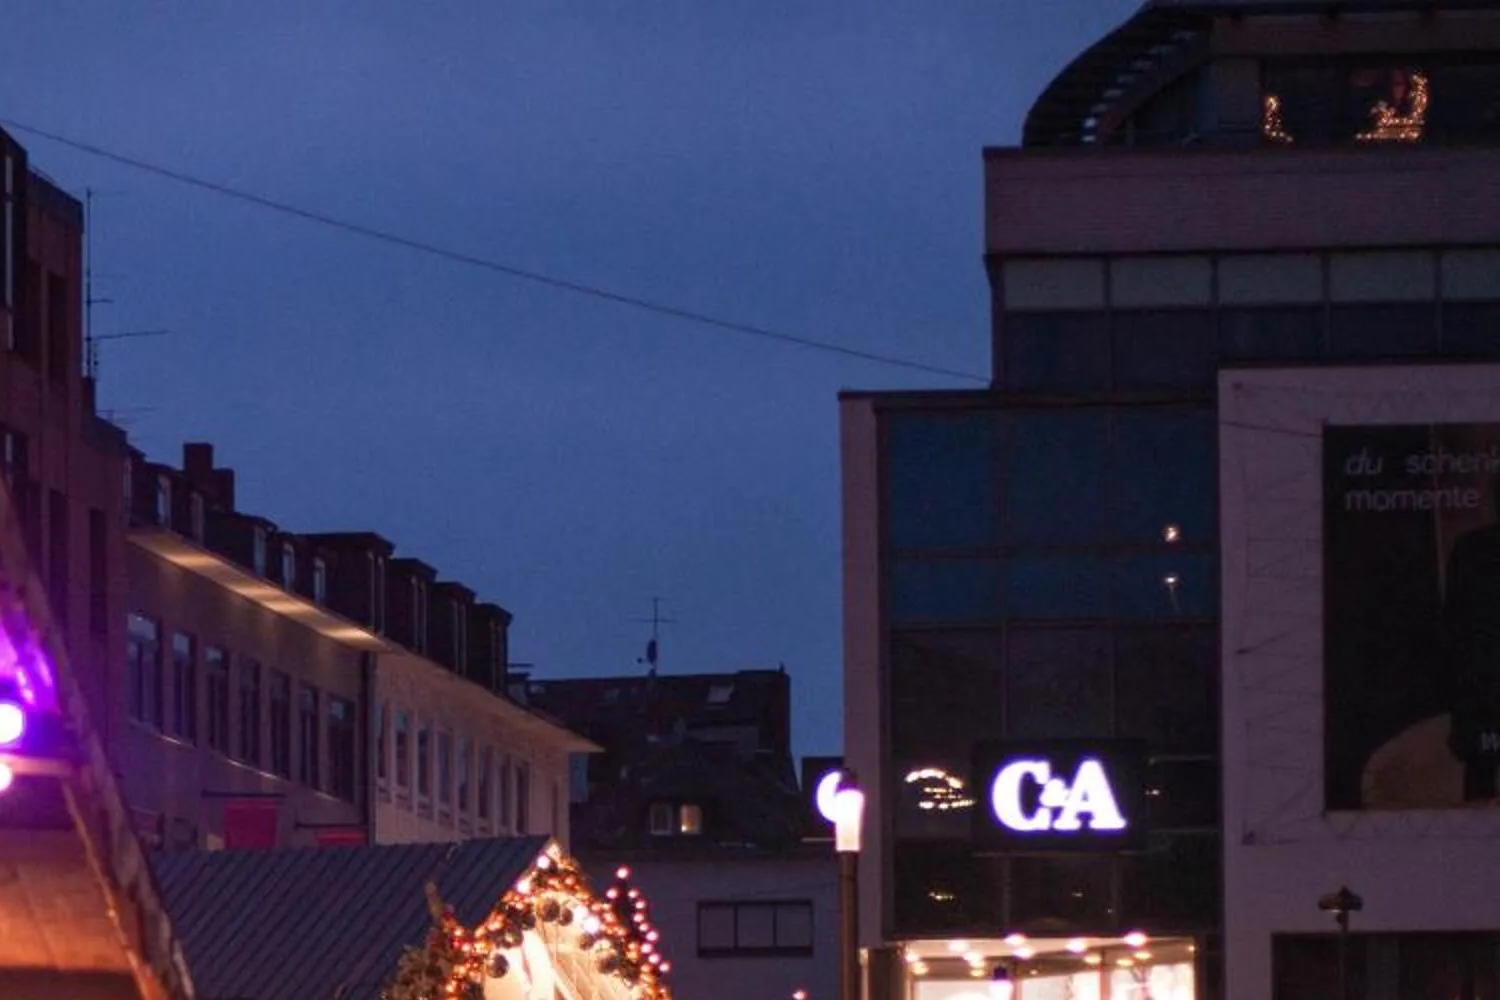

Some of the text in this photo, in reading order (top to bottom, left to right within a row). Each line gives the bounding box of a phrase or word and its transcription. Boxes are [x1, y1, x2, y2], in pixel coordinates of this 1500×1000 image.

[1345, 446, 1383, 475] du
[1344, 486, 1481, 512] momente
[992, 757, 1128, 831] C&A
